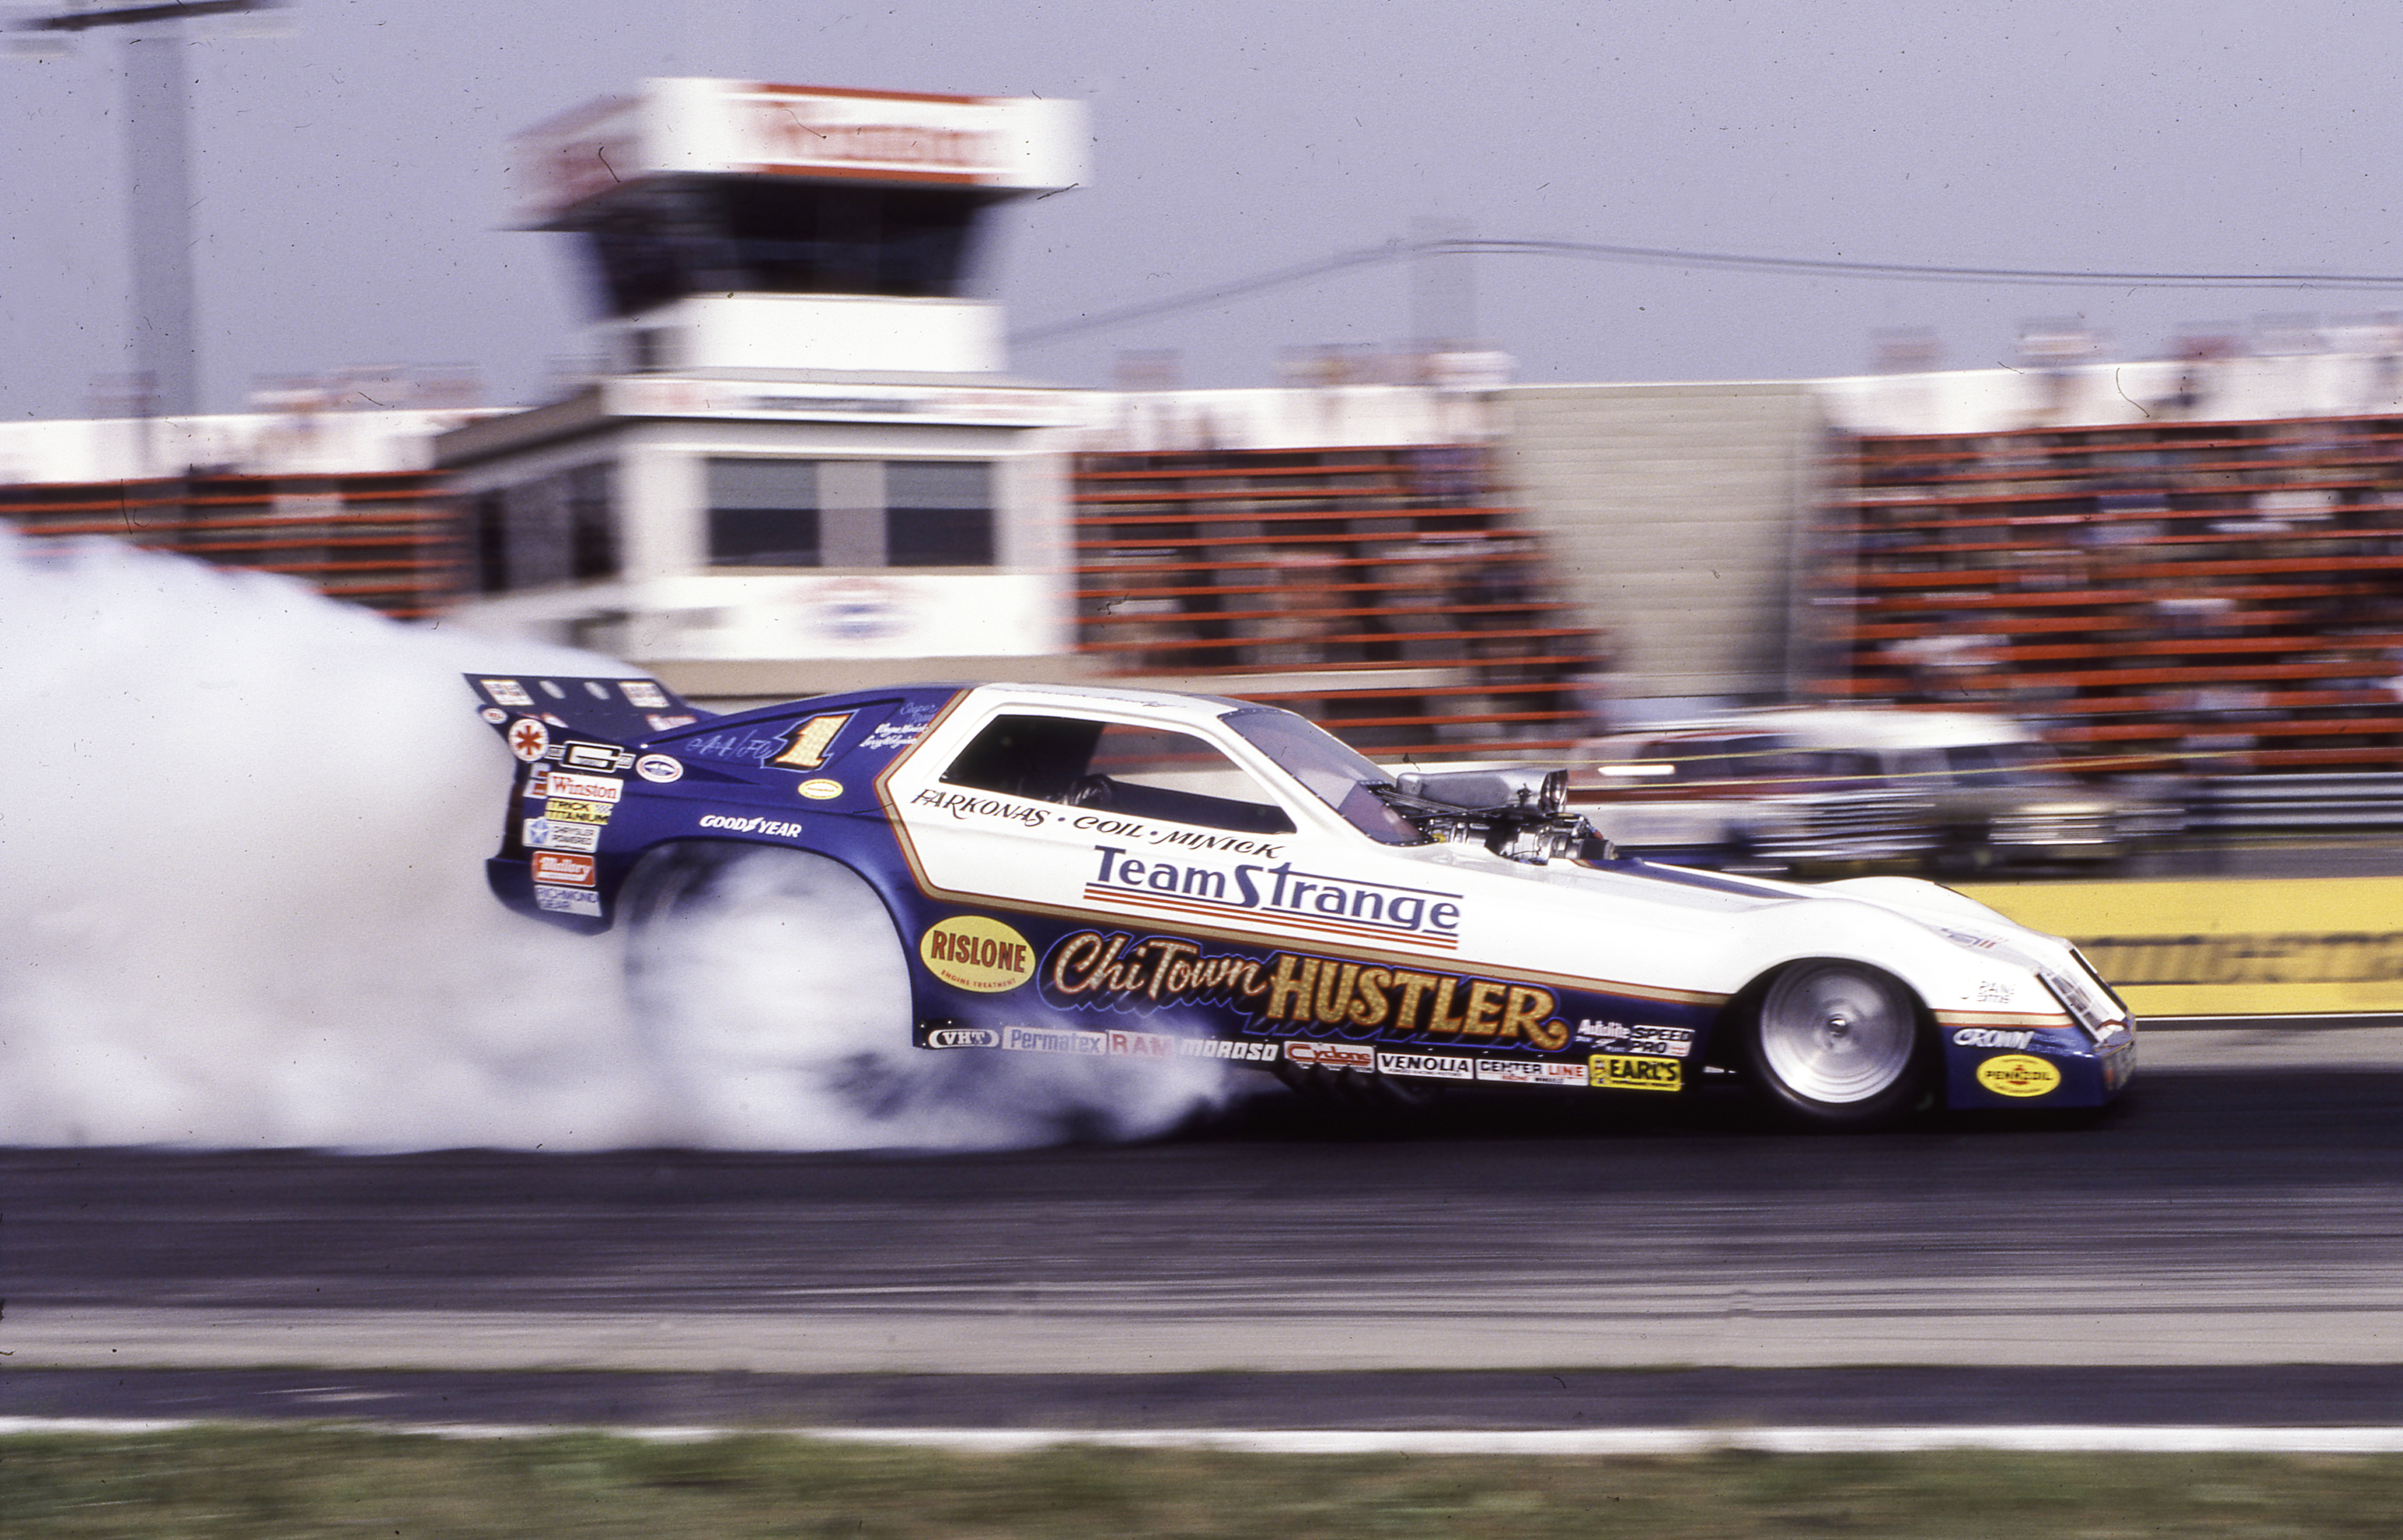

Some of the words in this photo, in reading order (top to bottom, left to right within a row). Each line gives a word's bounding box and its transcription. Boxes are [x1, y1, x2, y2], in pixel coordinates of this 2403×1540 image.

[764, 710, 858, 771] 1
[553, 776, 616, 799] Winston
[910, 789, 1052, 827] FARKONAS
[1073, 816, 1143, 838] COIL
[1149, 830, 1288, 859] MINICK
[930, 929, 1027, 973] RISLONE
[941, 970, 970, 986] ENGINE
[973, 978, 1016, 988] TREATMENT
[1266, 954, 1569, 1052] HUSTLER
[942, 1031, 986, 1045] VHT
[1577, 1019, 1631, 1039] Autolite
[1633, 1027, 1690, 1040] SPEED
[1953, 1028, 2036, 1050] CROWN
[1010, 1028, 1101, 1053] Permatex
[1630, 1041, 1667, 1053] PRO
[1287, 1043, 1372, 1067] Cyclone
[1381, 1055, 1469, 1072] VENOLIA
[1481, 1061, 1542, 1075] CENTER
[1549, 1065, 1584, 1077] LINE
[1610, 1059, 1676, 1082] EARL'S
[1986, 1070, 2053, 1081] PENNZOIL
